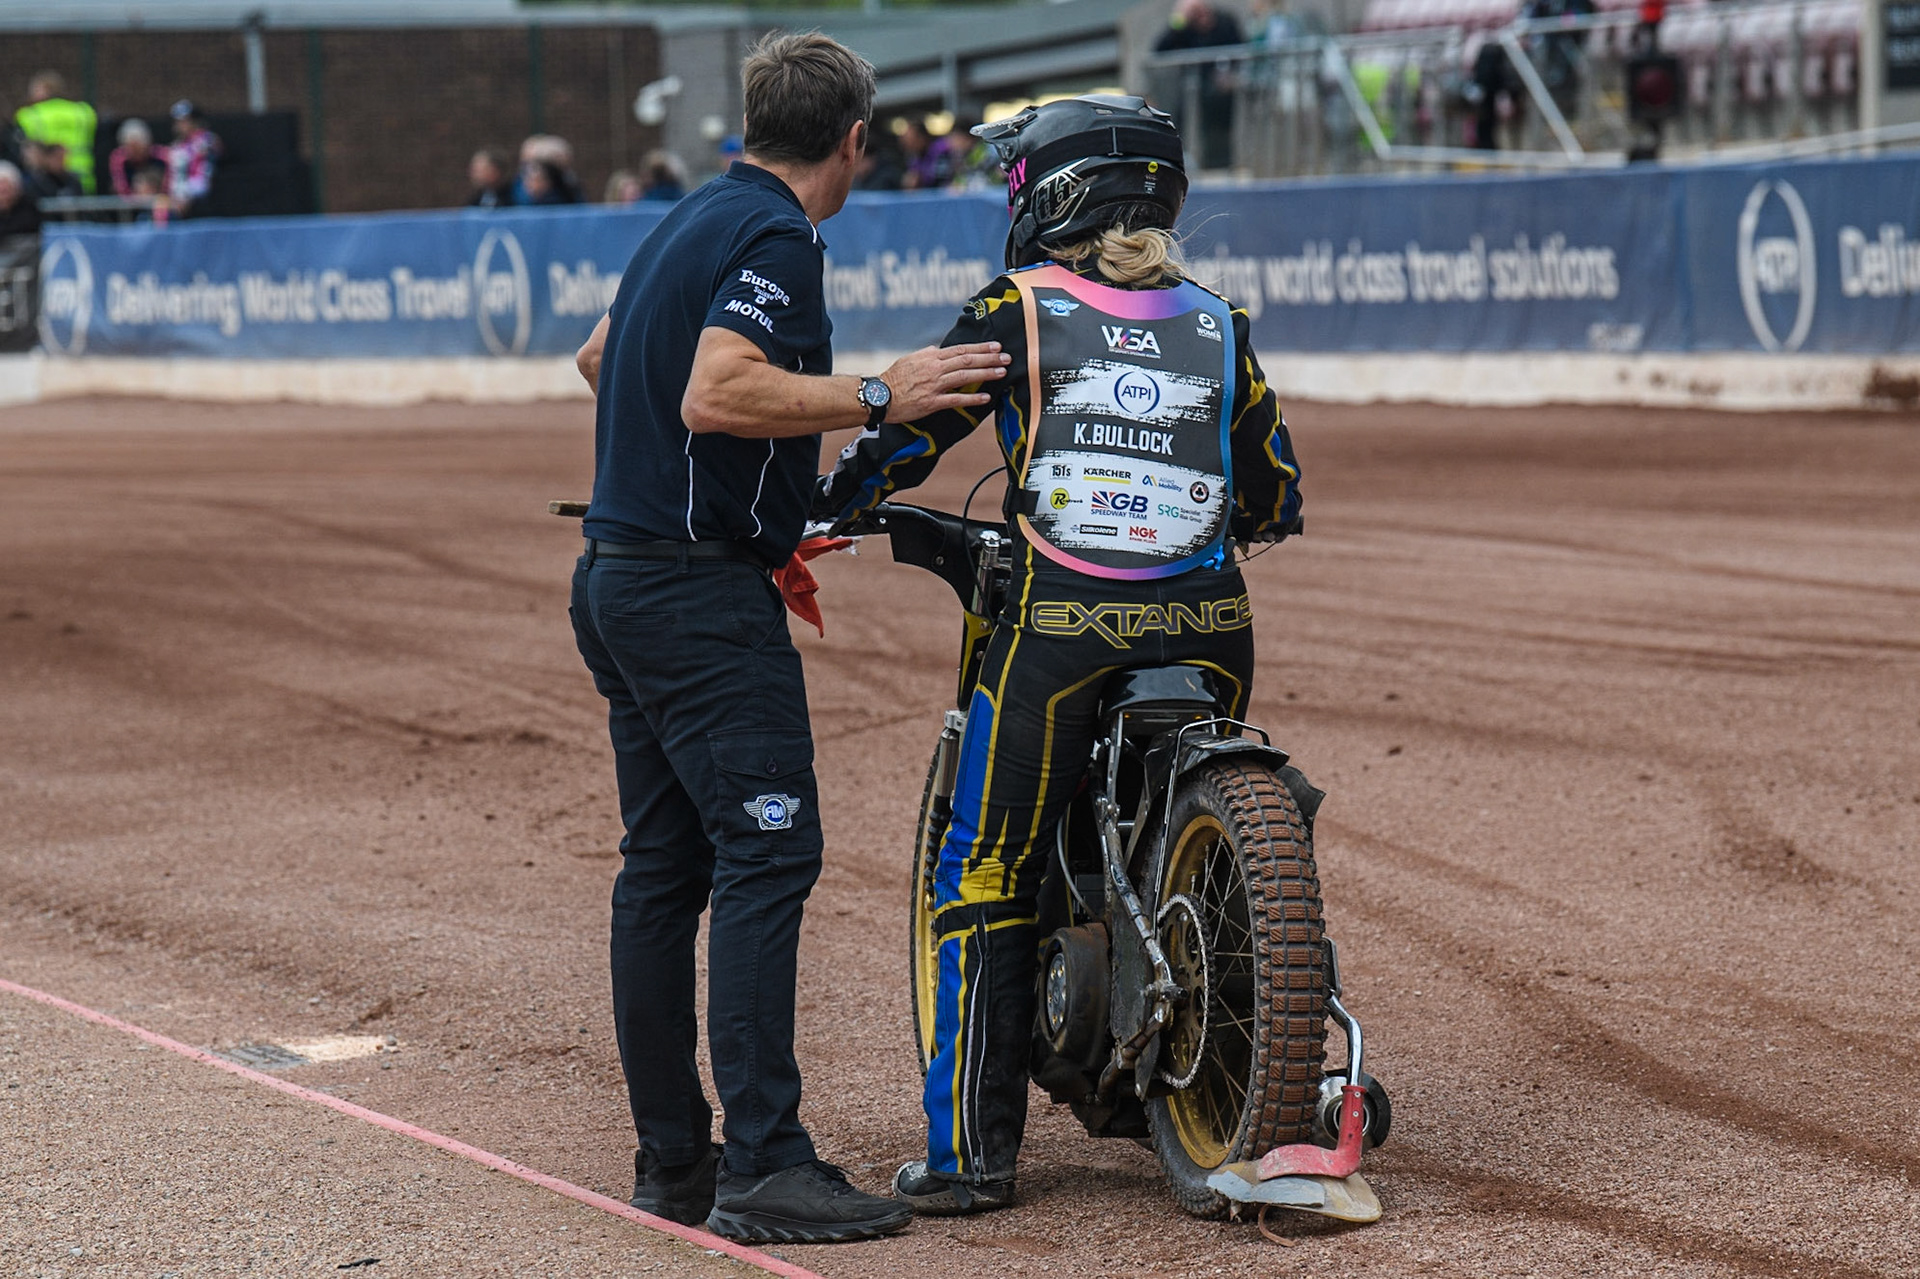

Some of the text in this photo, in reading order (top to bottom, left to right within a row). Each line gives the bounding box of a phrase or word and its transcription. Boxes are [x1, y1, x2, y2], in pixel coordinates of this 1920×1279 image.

[1008, 157, 1027, 198] FLY
[1264, 237, 1335, 305] world
[1335, 236, 1408, 304] class
[1406, 233, 1487, 303] travel
[1486, 230, 1621, 300] solutions
[739, 269, 791, 307] Europe
[105, 262, 471, 338] Delivering World Class Travel
[724, 299, 774, 334] MOTUL
[1101, 325, 1162, 355] WSA
[1121, 384, 1152, 401] ATPI
[1074, 422, 1174, 456] K.BULLOCK
[1083, 467, 1132, 479] KÄRCHER
[1158, 483, 1184, 493] Mobility
[1110, 493, 1149, 513] GB
[1158, 504, 1180, 518] SRG
[1090, 508, 1148, 520] SPEEDWAY TEAM
[1081, 525, 1117, 535] Silkolene
[1129, 526, 1158, 540] NGK
[765, 804, 784, 819] FIM
